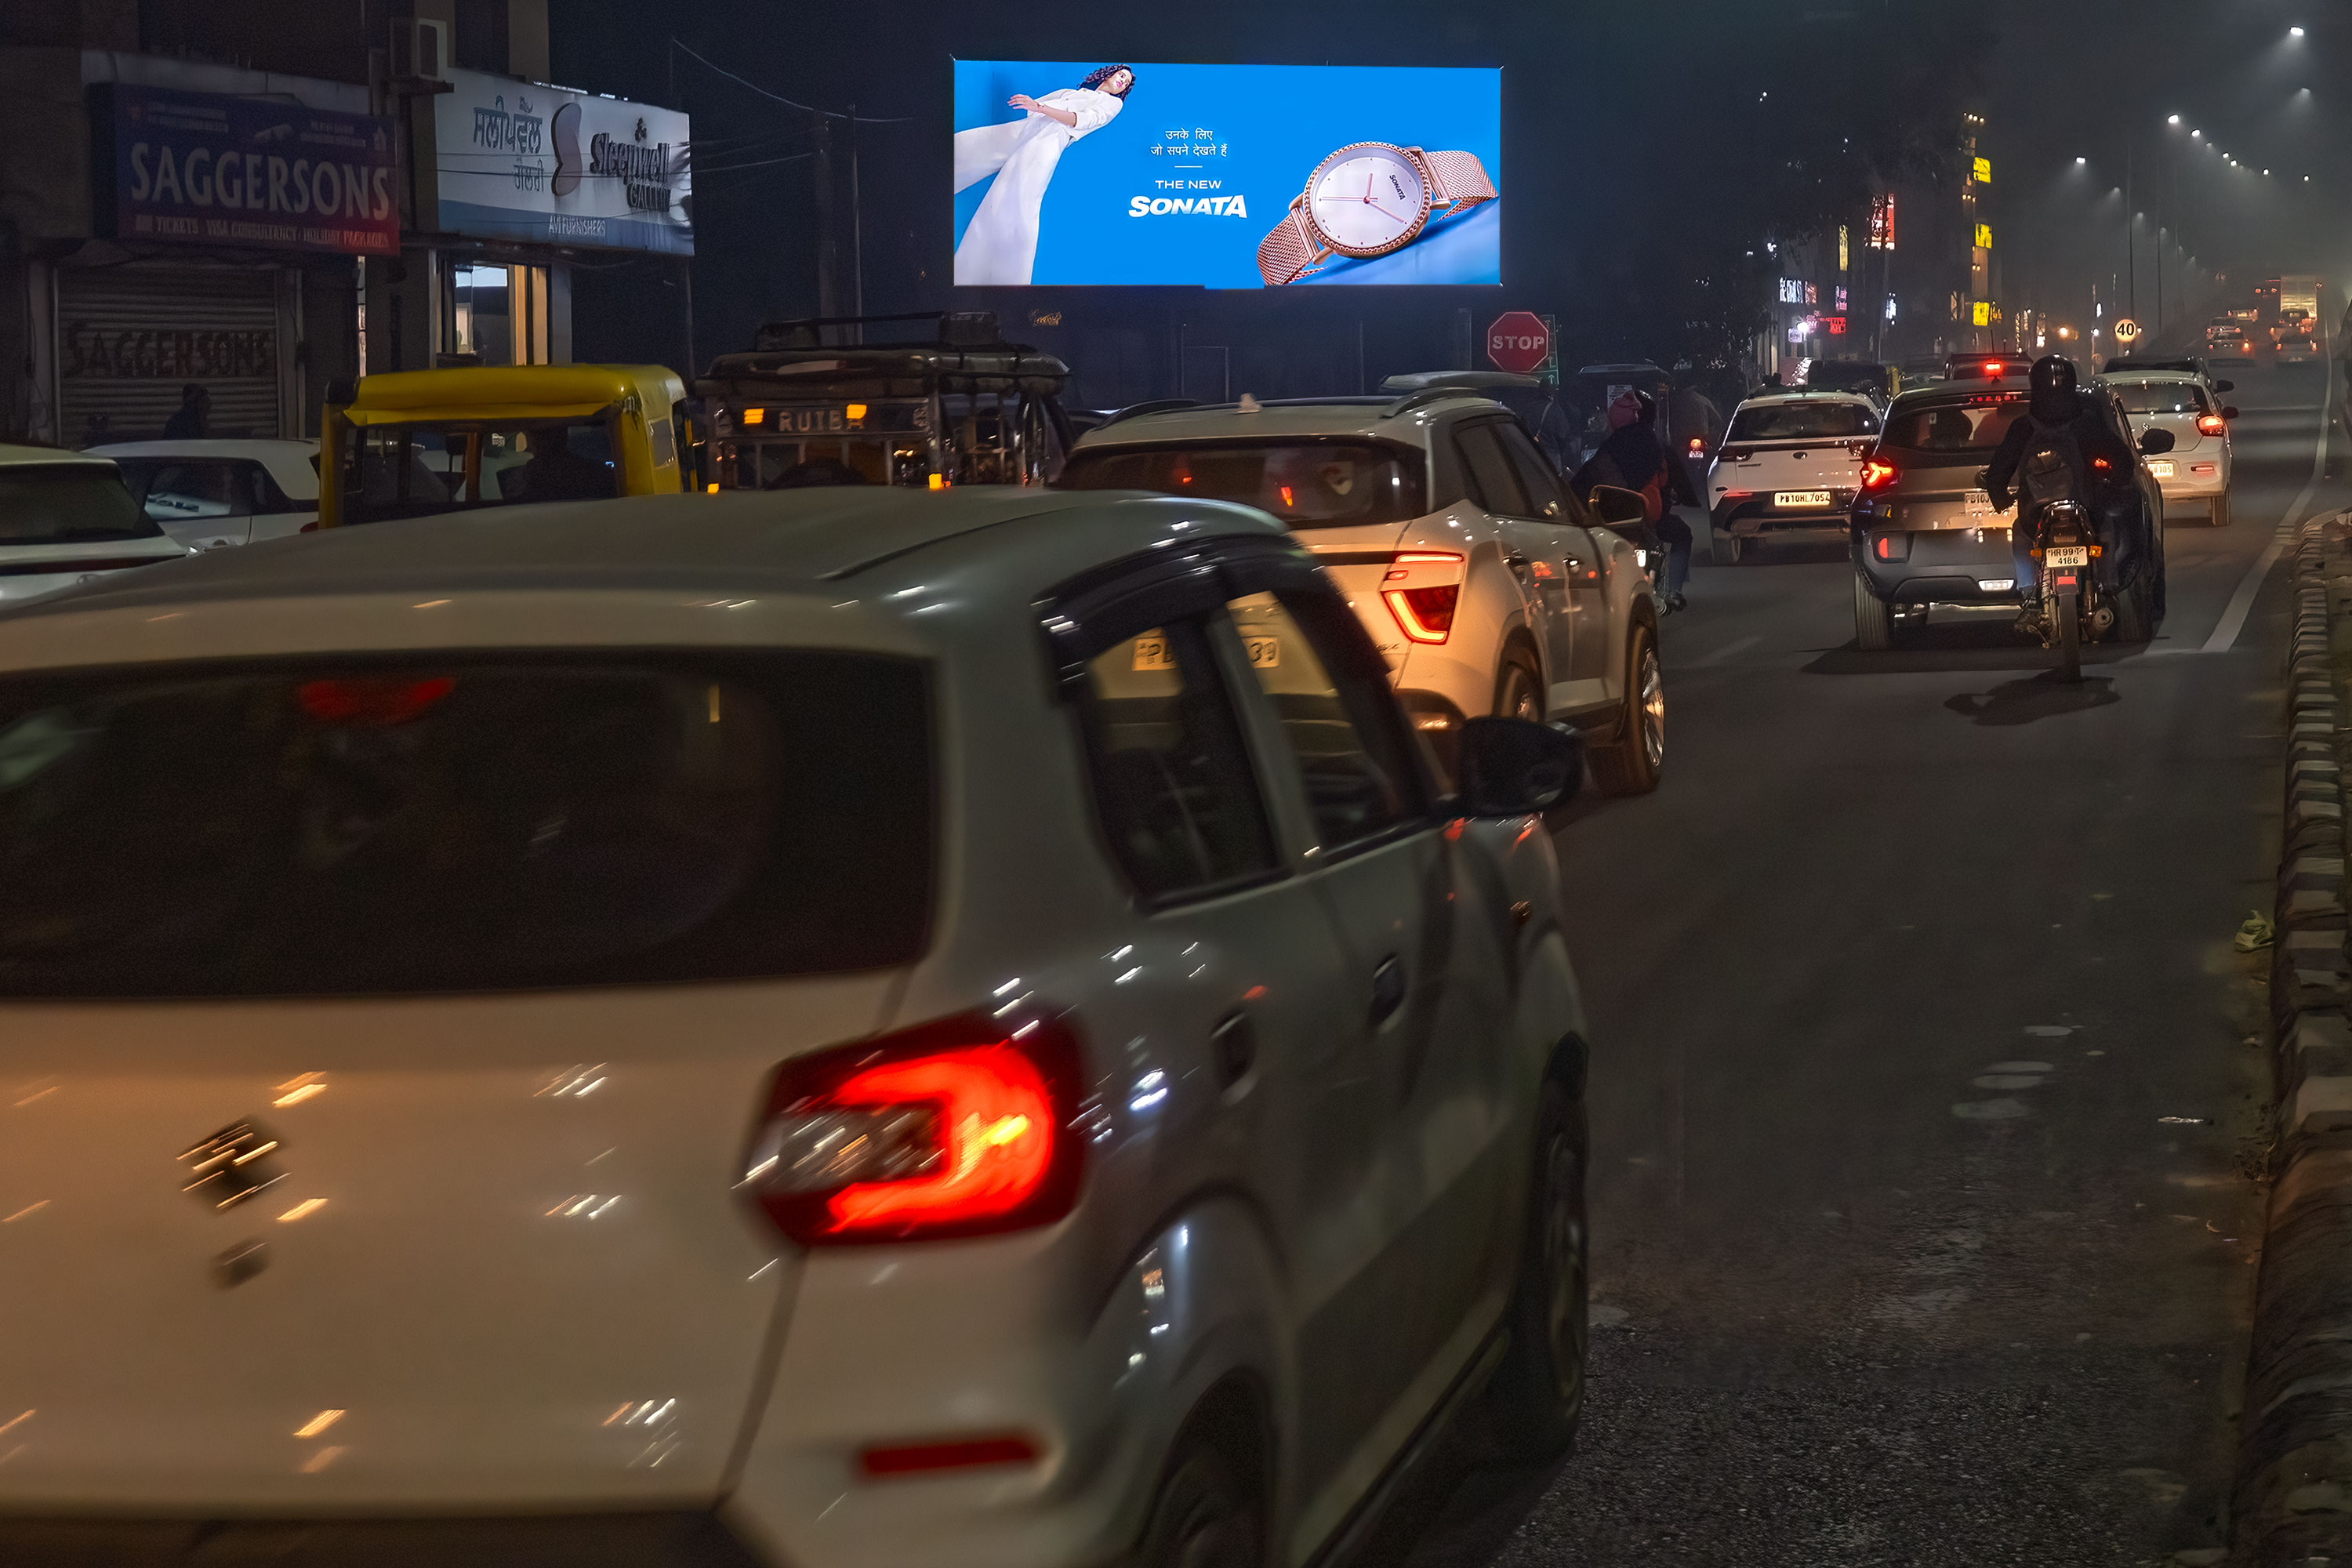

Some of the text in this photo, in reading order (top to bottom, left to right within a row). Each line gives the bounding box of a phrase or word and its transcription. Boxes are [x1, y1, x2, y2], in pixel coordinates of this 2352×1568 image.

[1165, 128, 1213, 140] उनके लिए
[1150, 143, 1163, 156] जो
[1167, 143, 1189, 156] सपने
[1192, 143, 1216, 157] देखते
[131, 142, 389, 221] SAGGERSONS
[1155, 180, 1221, 189] THE NEW
[1389, 174, 1406, 200] SONATA
[1128, 194, 1247, 218] SONATA
[2117, 323, 2135, 336] 40
[1492, 336, 1544, 350] STOP
